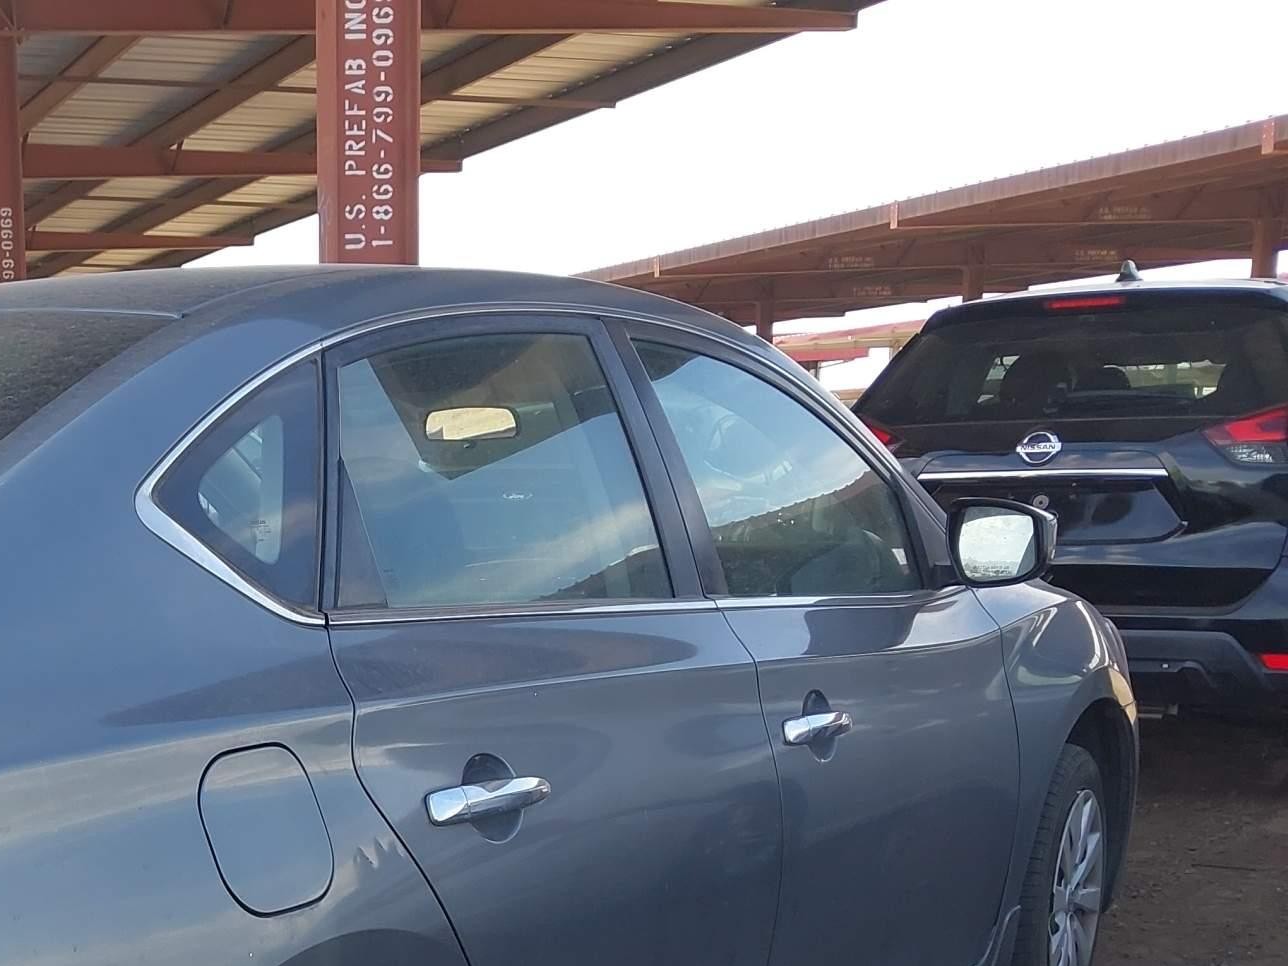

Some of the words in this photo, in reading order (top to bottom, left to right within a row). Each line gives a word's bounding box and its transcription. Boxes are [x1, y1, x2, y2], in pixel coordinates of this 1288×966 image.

[344, 58, 367, 176] PREFAB
[371, 0, 394, 247] 1-866-799-096
[344, 194, 367, 250] U.S.
[1021, 443, 1056, 451] NISSAN
